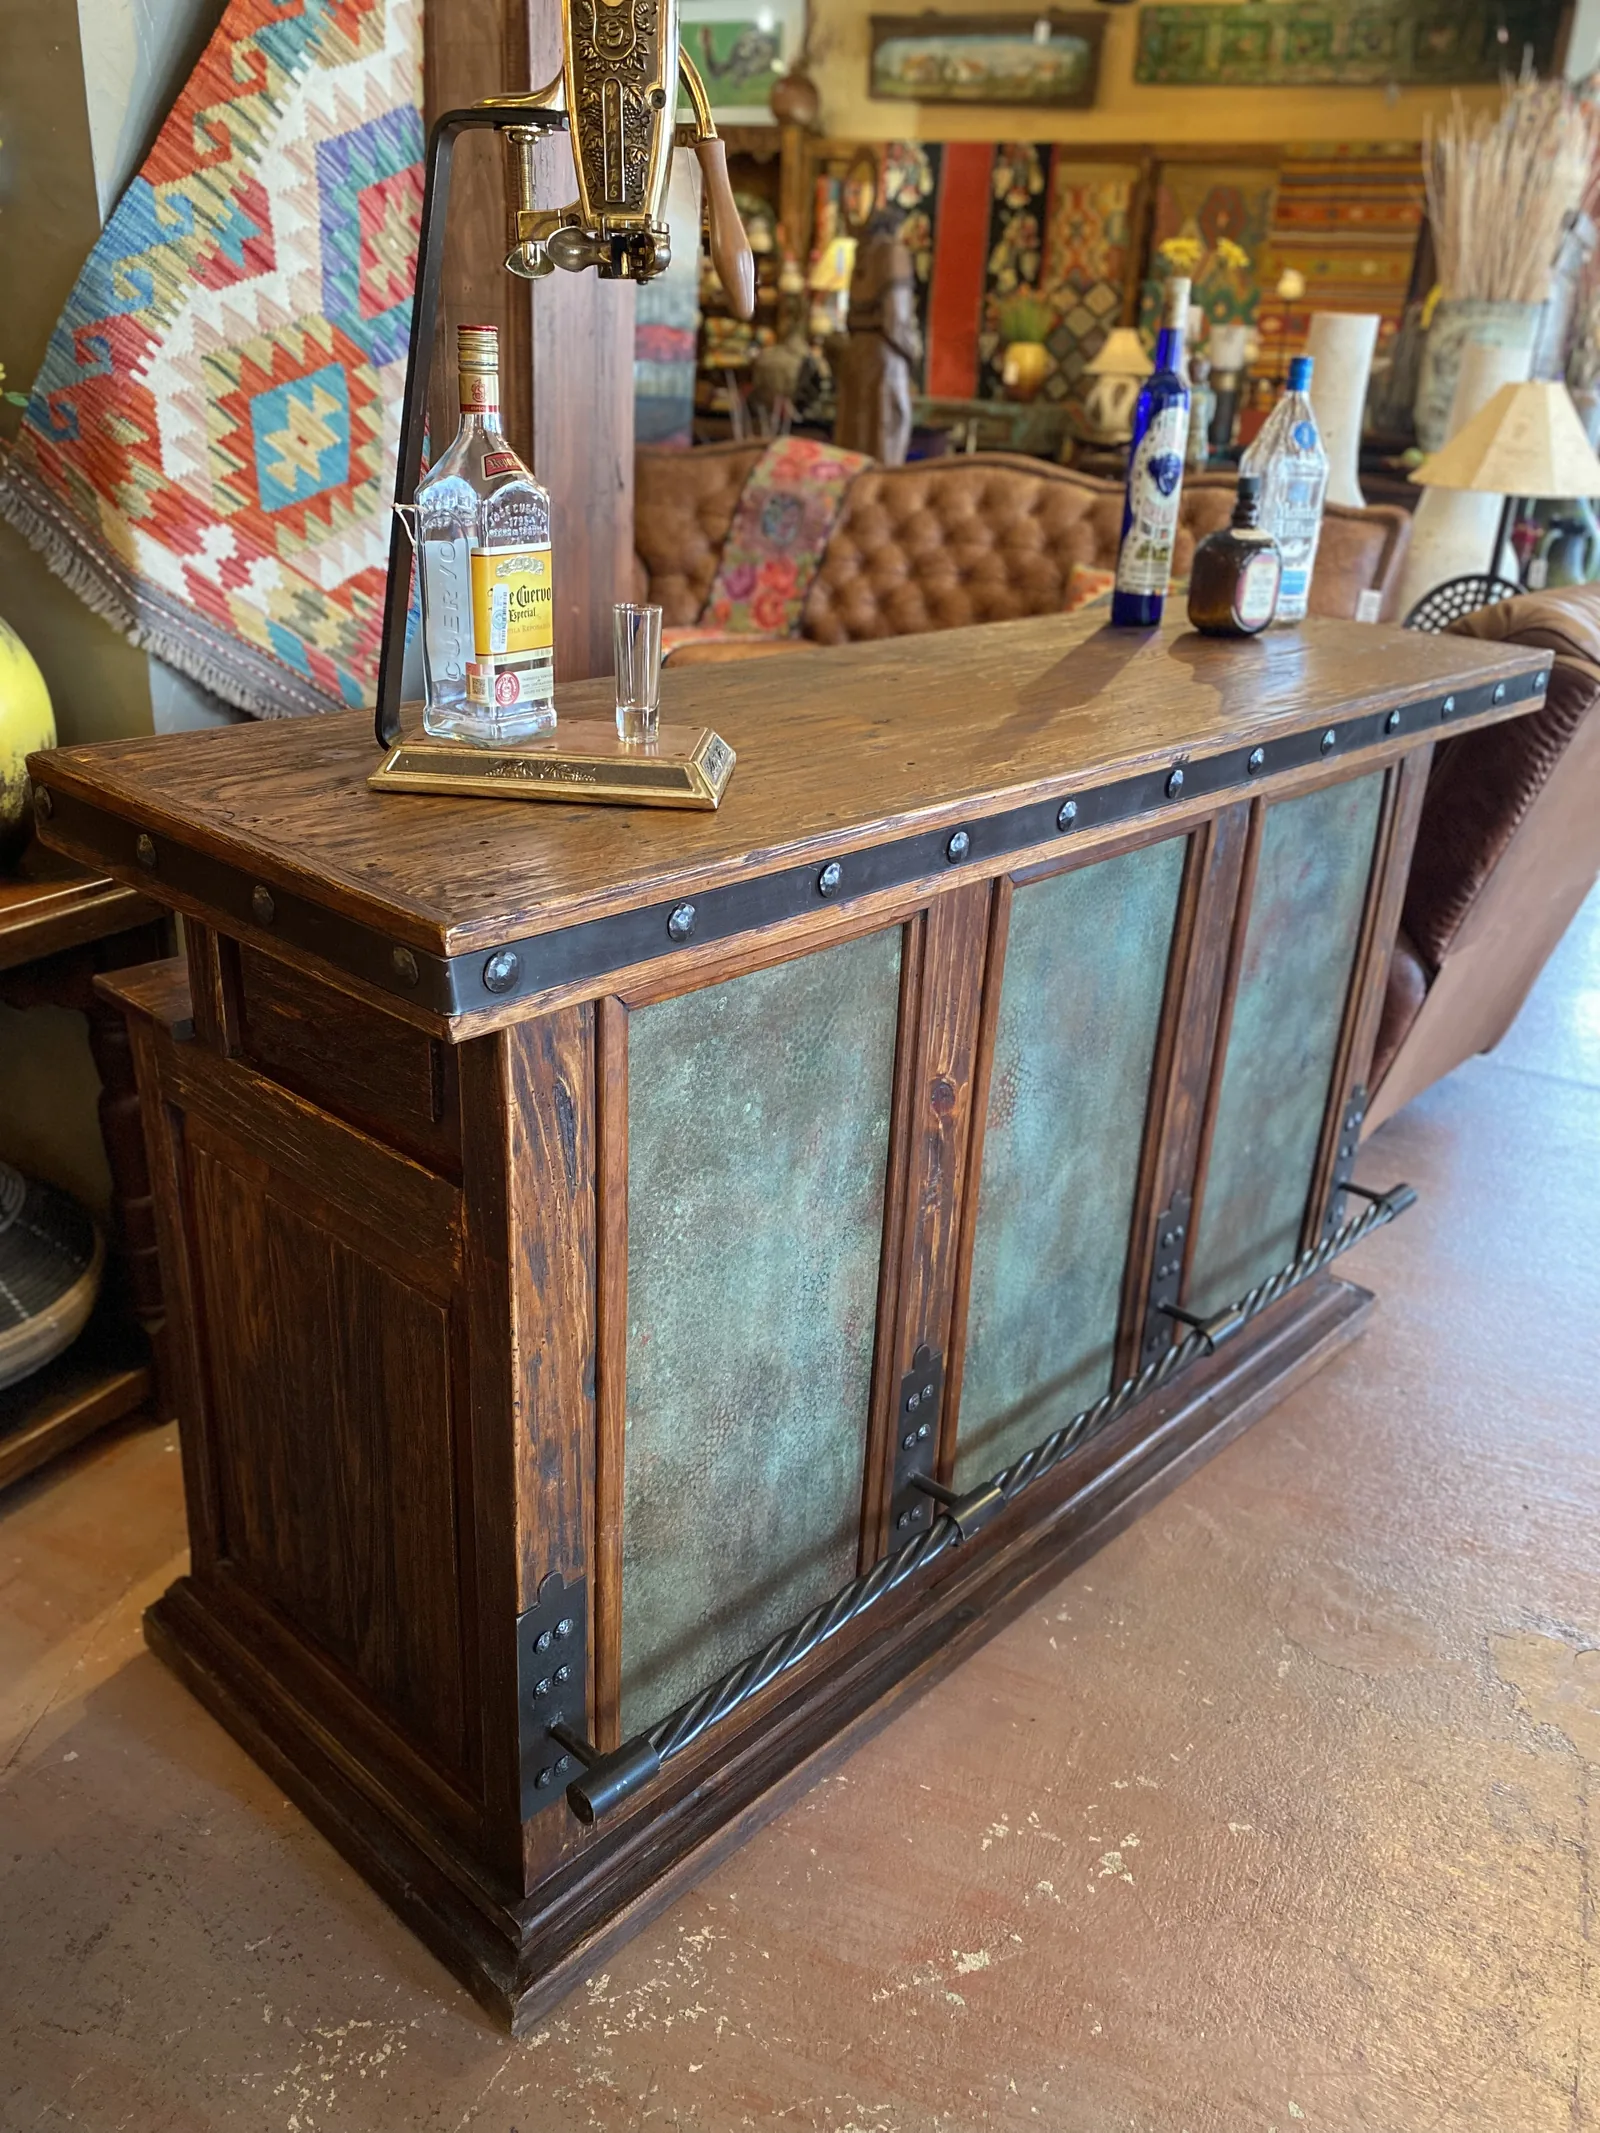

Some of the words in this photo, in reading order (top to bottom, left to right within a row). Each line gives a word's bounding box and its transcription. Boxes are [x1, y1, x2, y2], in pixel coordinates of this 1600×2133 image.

[516, 584, 552, 608] Cuervo
[439, 541, 462, 680] CUERVO
[508, 607, 536, 623] Especial
